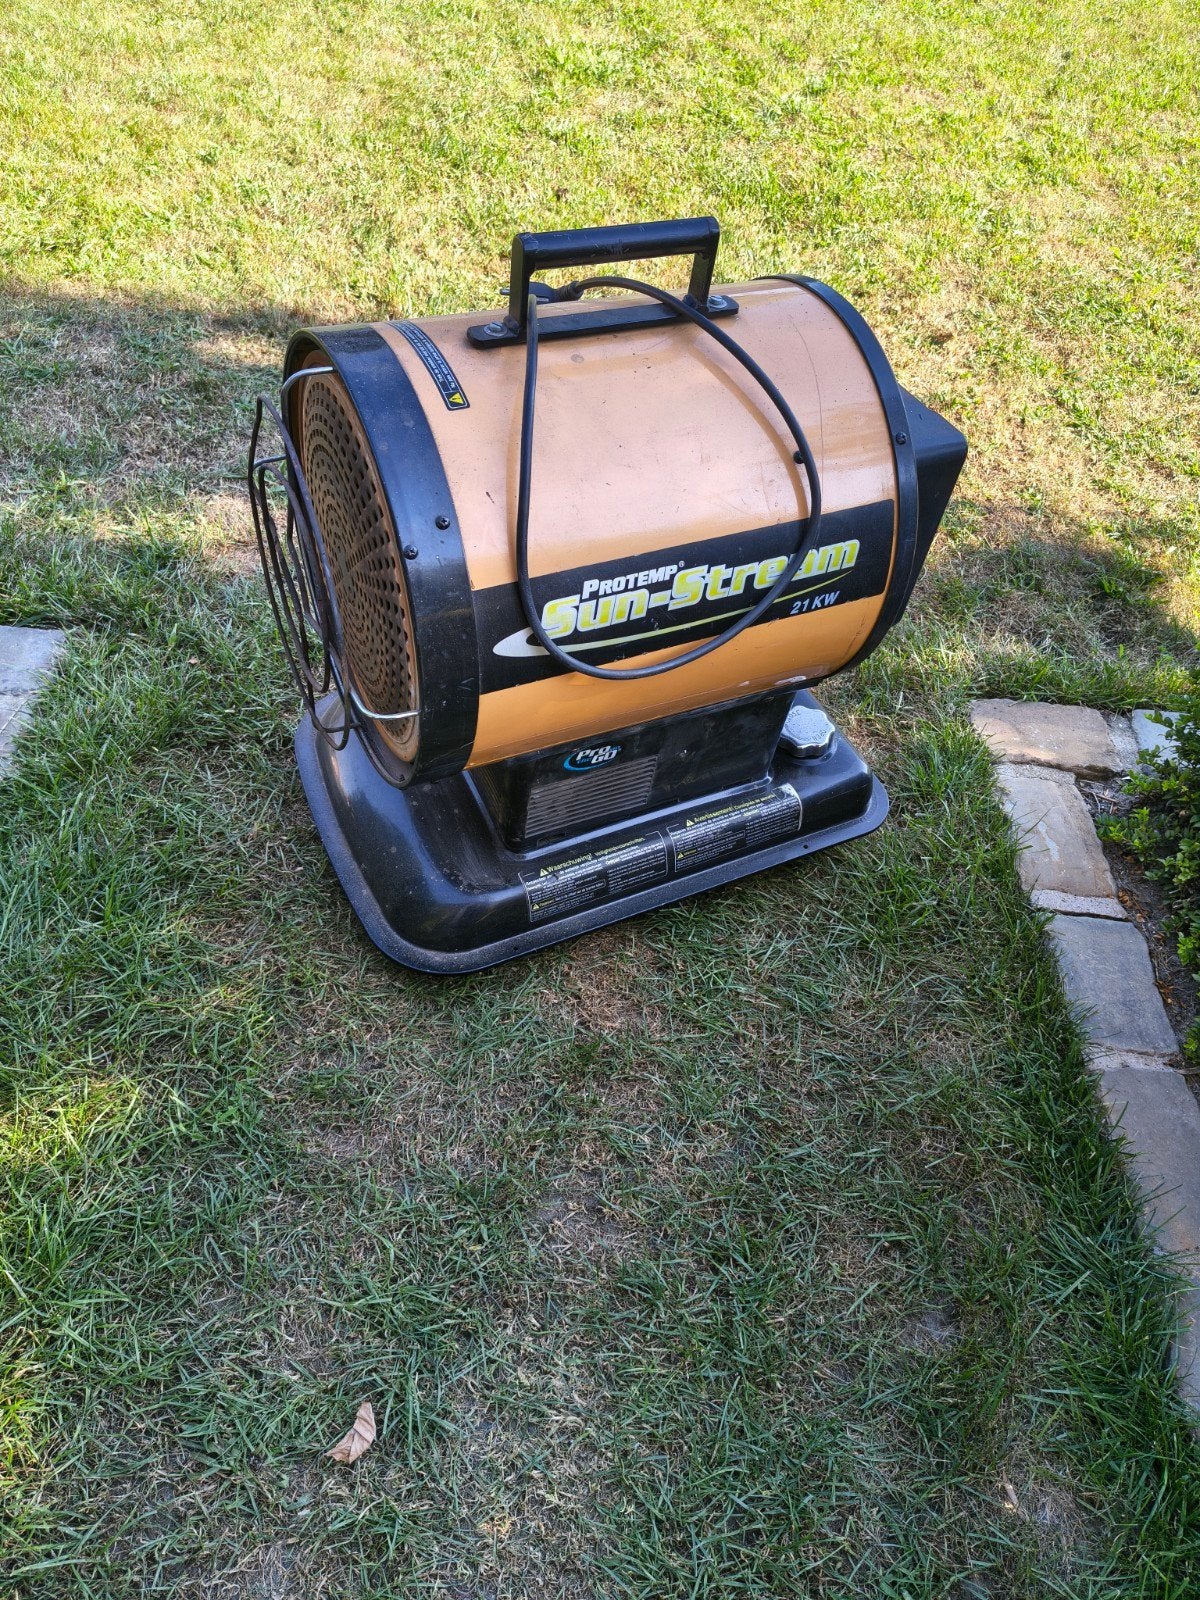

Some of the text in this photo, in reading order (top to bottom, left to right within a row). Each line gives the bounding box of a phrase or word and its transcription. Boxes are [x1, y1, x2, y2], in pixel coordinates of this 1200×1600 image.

[790, 590, 840, 615] 21 KW
[575, 745, 612, 761] Pro
